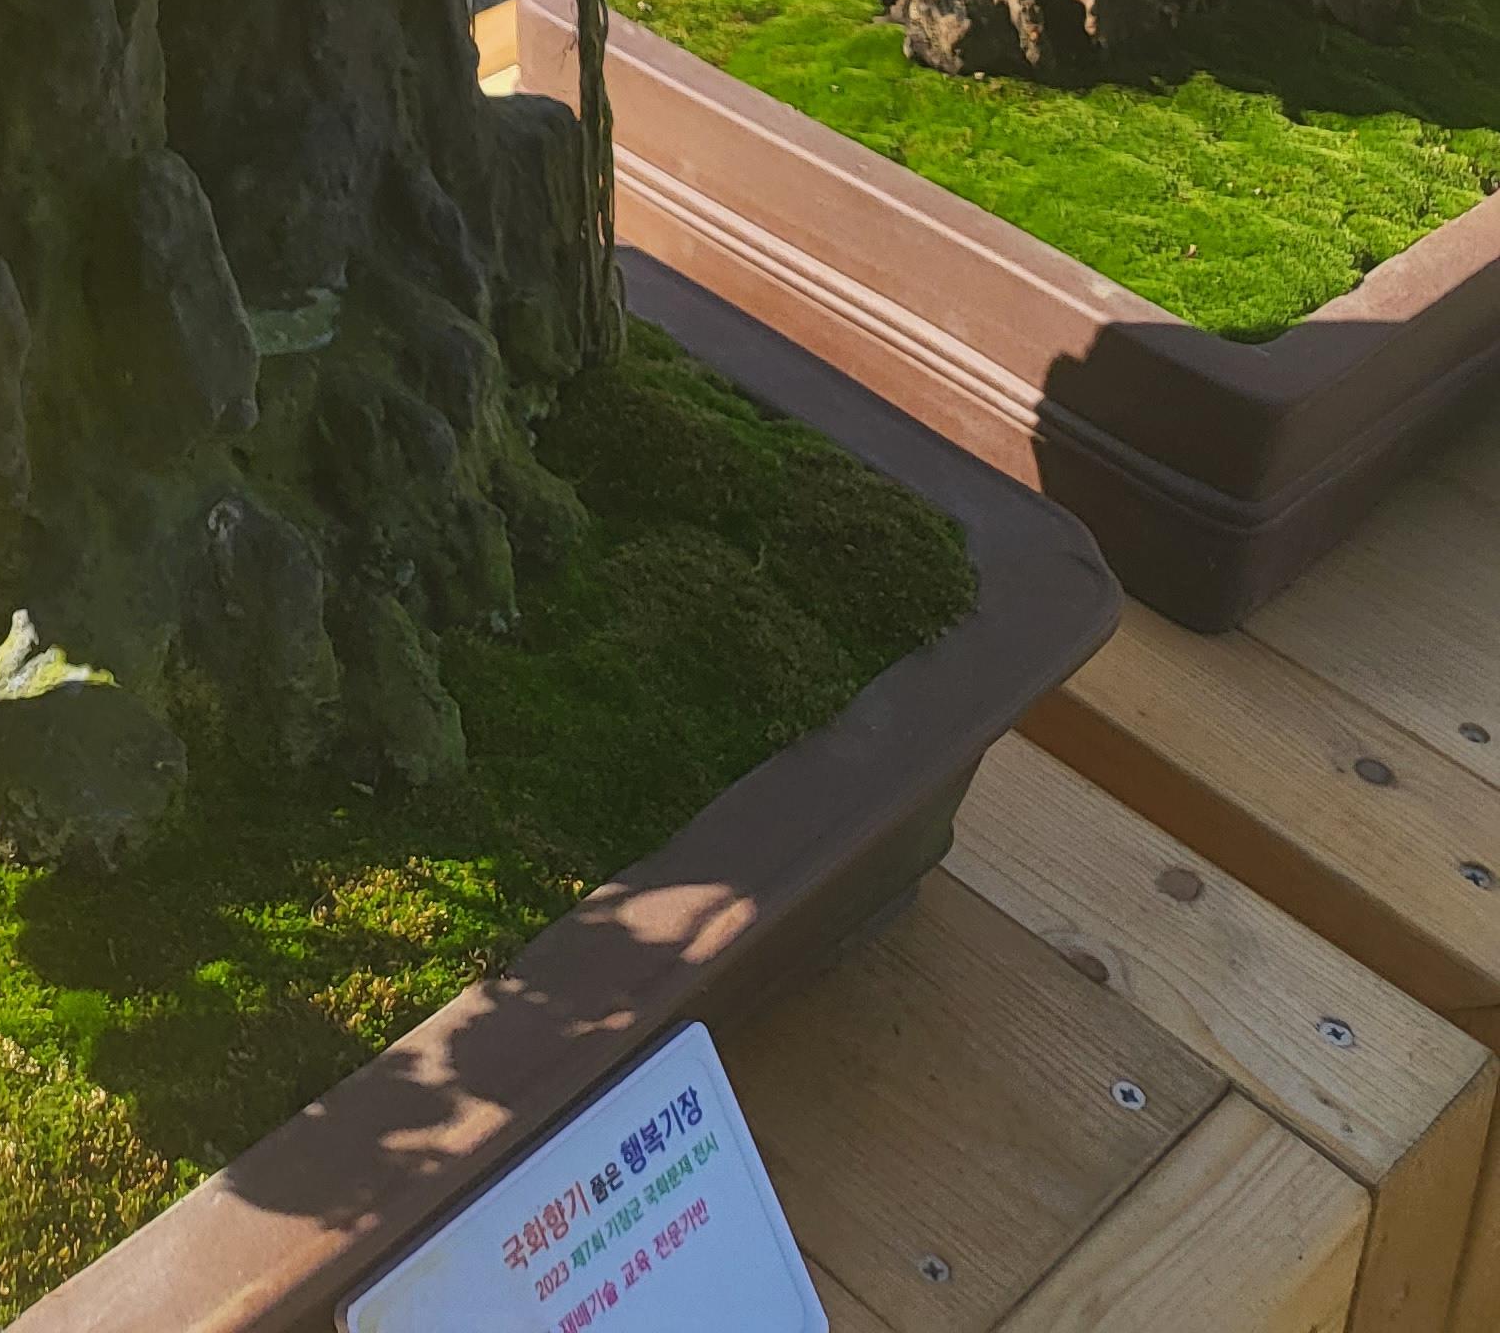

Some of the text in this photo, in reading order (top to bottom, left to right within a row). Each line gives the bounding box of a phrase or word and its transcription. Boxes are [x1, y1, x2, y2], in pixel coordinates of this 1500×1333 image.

[502, 1181, 590, 1270] 국화향기
[621, 1085, 703, 1174] 행복기장
[535, 1260, 570, 1302] 2023
[604, 1196, 644, 1239] 기장군
[691, 1130, 719, 1165] 전시
[558, 1197, 711, 1333] 재배기술 교육 전문가반
